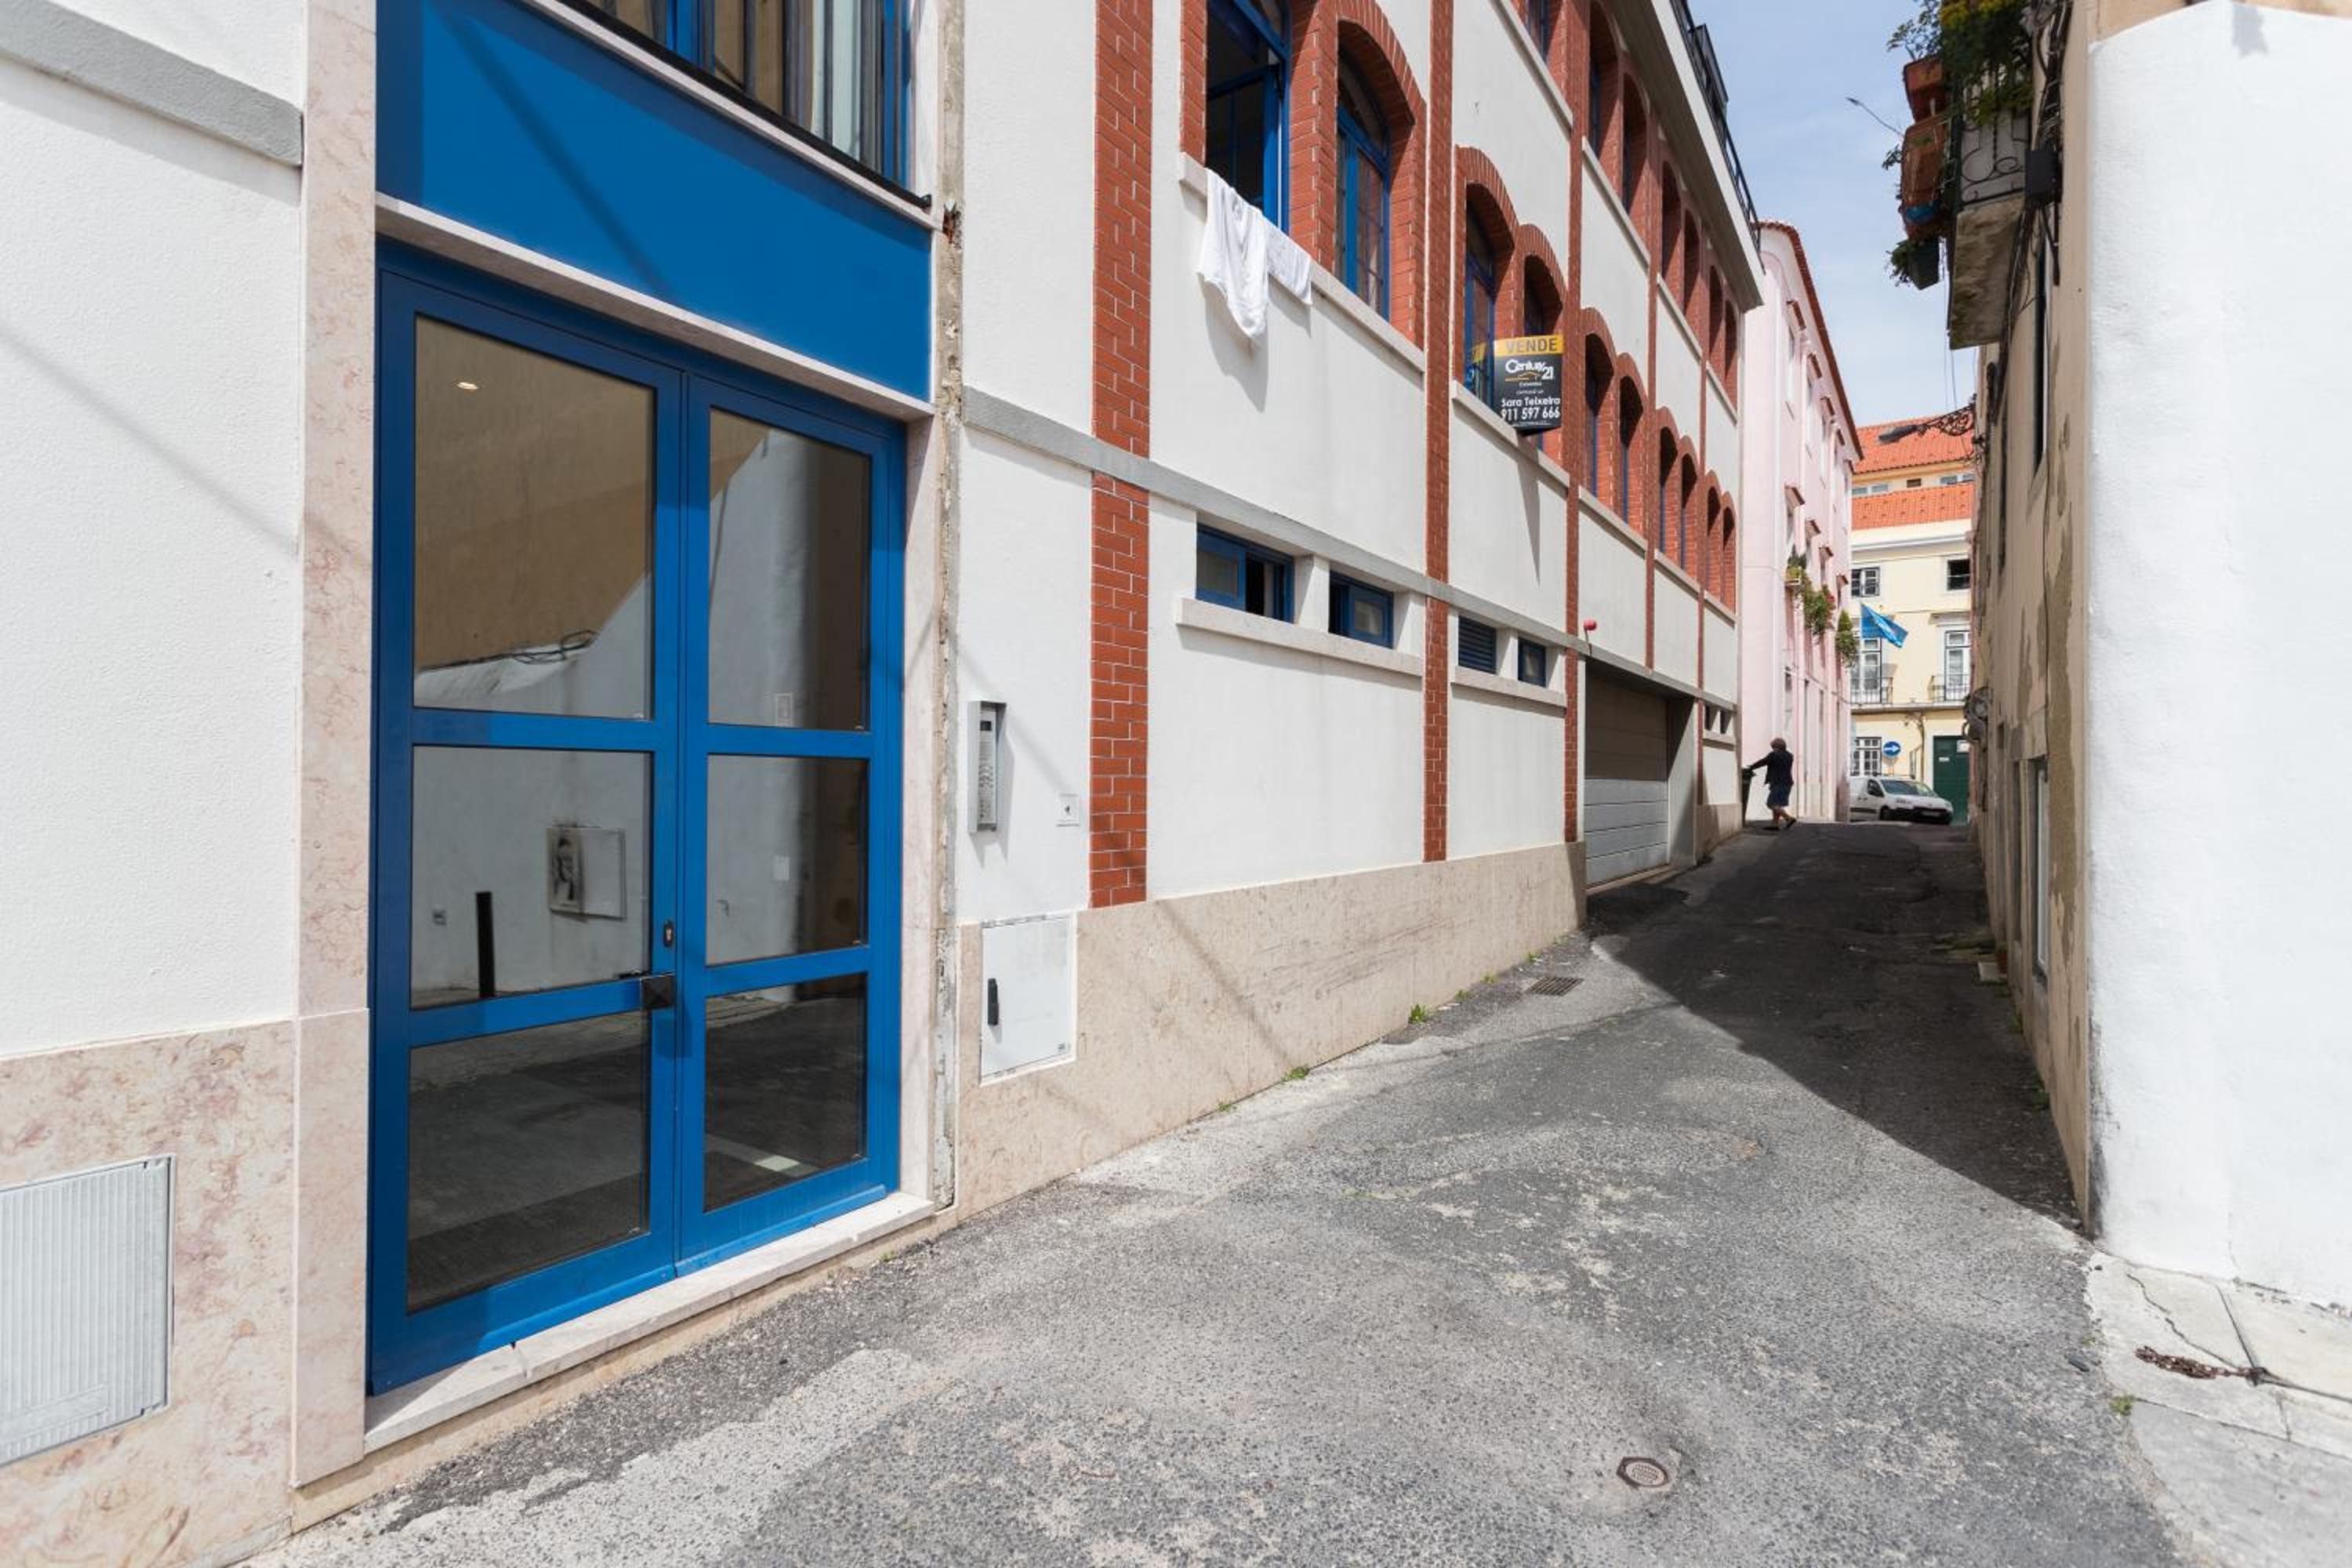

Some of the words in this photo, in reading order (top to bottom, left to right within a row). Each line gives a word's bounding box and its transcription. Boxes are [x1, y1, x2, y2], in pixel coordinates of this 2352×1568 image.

[1506, 338, 1558, 354] VENDE
[1505, 358, 1545, 373] Century
[1541, 366, 1554, 379] 21
[1501, 397, 1522, 407] Sara
[1524, 396, 1561, 406] Teixeira
[1501, 408, 1518, 421] 911
[1521, 407, 1541, 419] 597
[1542, 405, 1561, 419] 666
